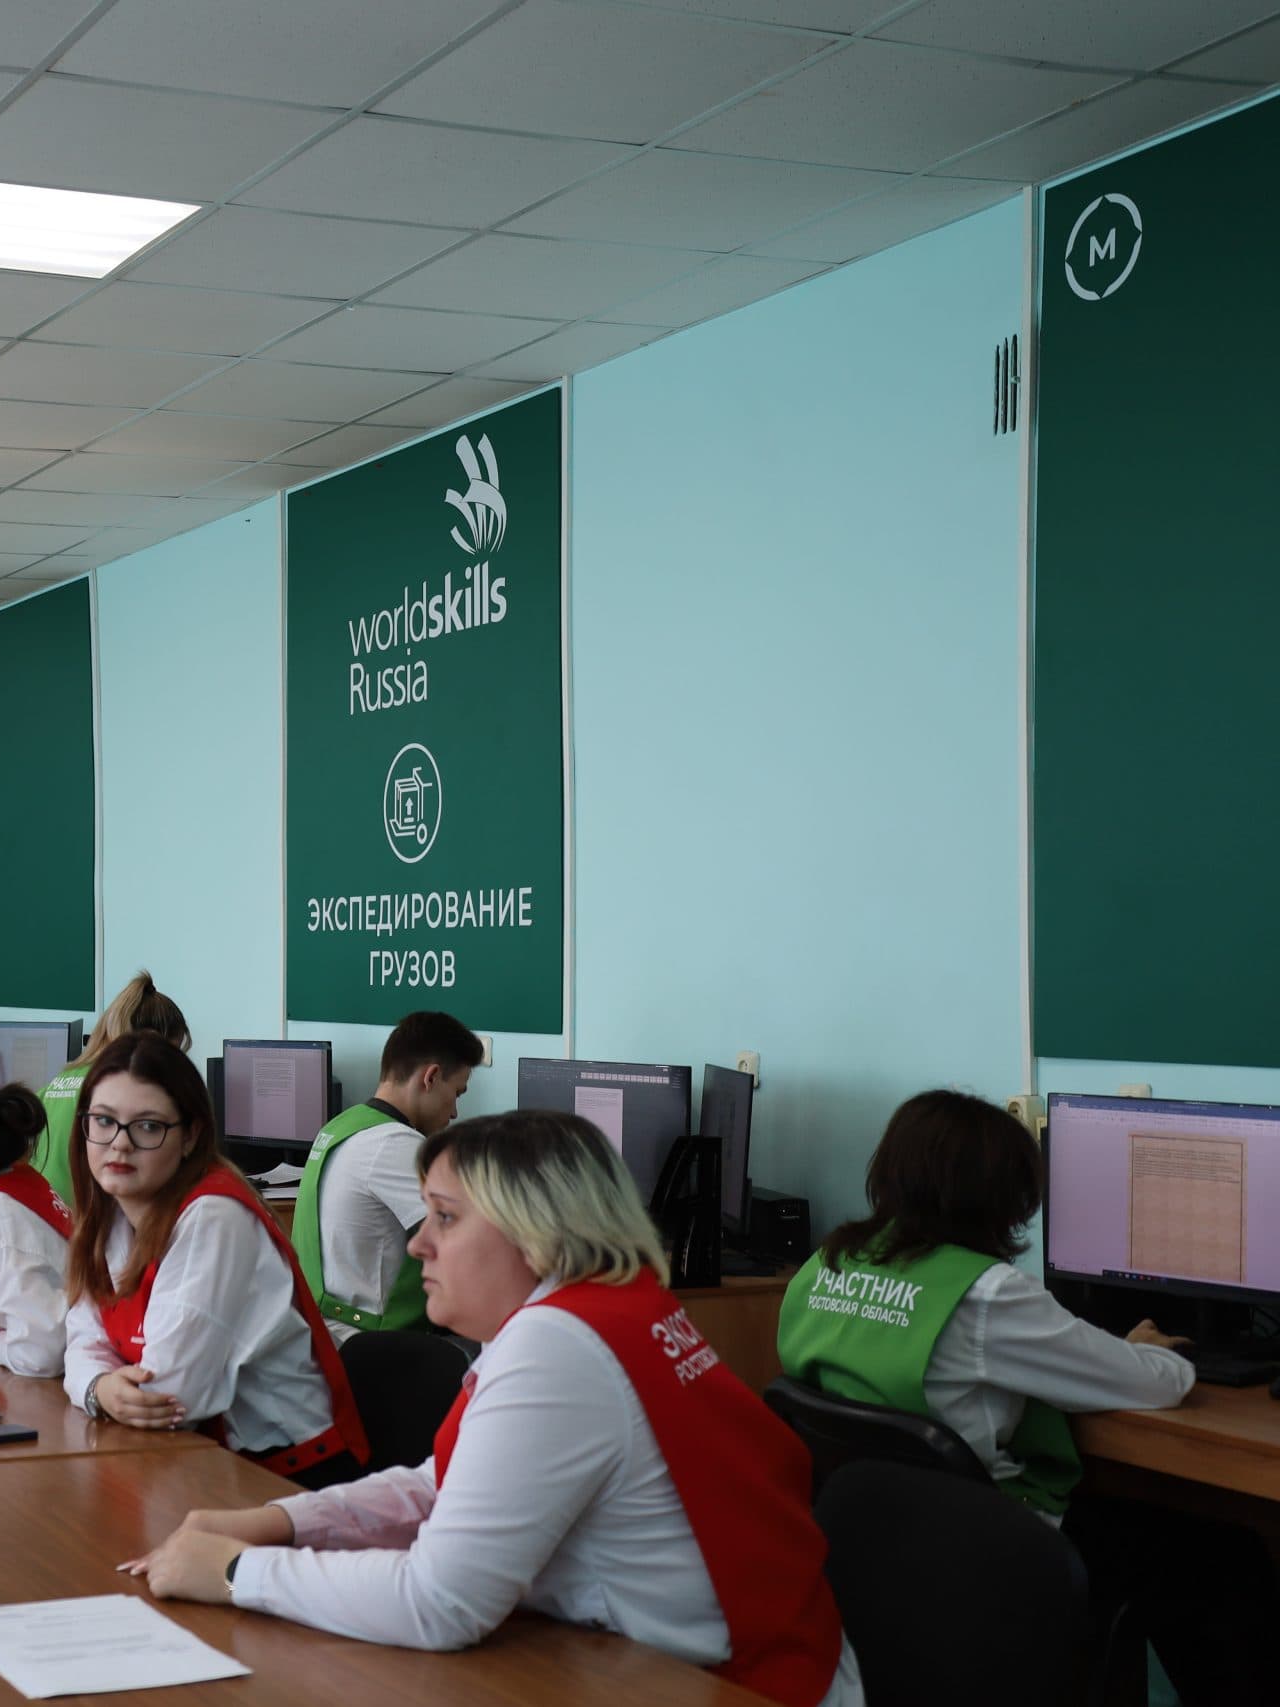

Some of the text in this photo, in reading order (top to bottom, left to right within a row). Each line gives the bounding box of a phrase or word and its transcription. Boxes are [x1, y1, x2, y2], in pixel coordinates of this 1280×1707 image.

[1089, 227, 1116, 267] М
[348, 560, 508, 657] worldskills
[349, 647, 428, 715] Russia
[307, 886, 532, 937] ЭКСПЕДИРОВАНИЕ
[369, 950, 455, 987] ГРУЗОВ
[811, 1266, 923, 1311] УЧАСТНИК
[808, 1295, 910, 1328] РОСТОВСКАЯ ОБЛАСТЬ
